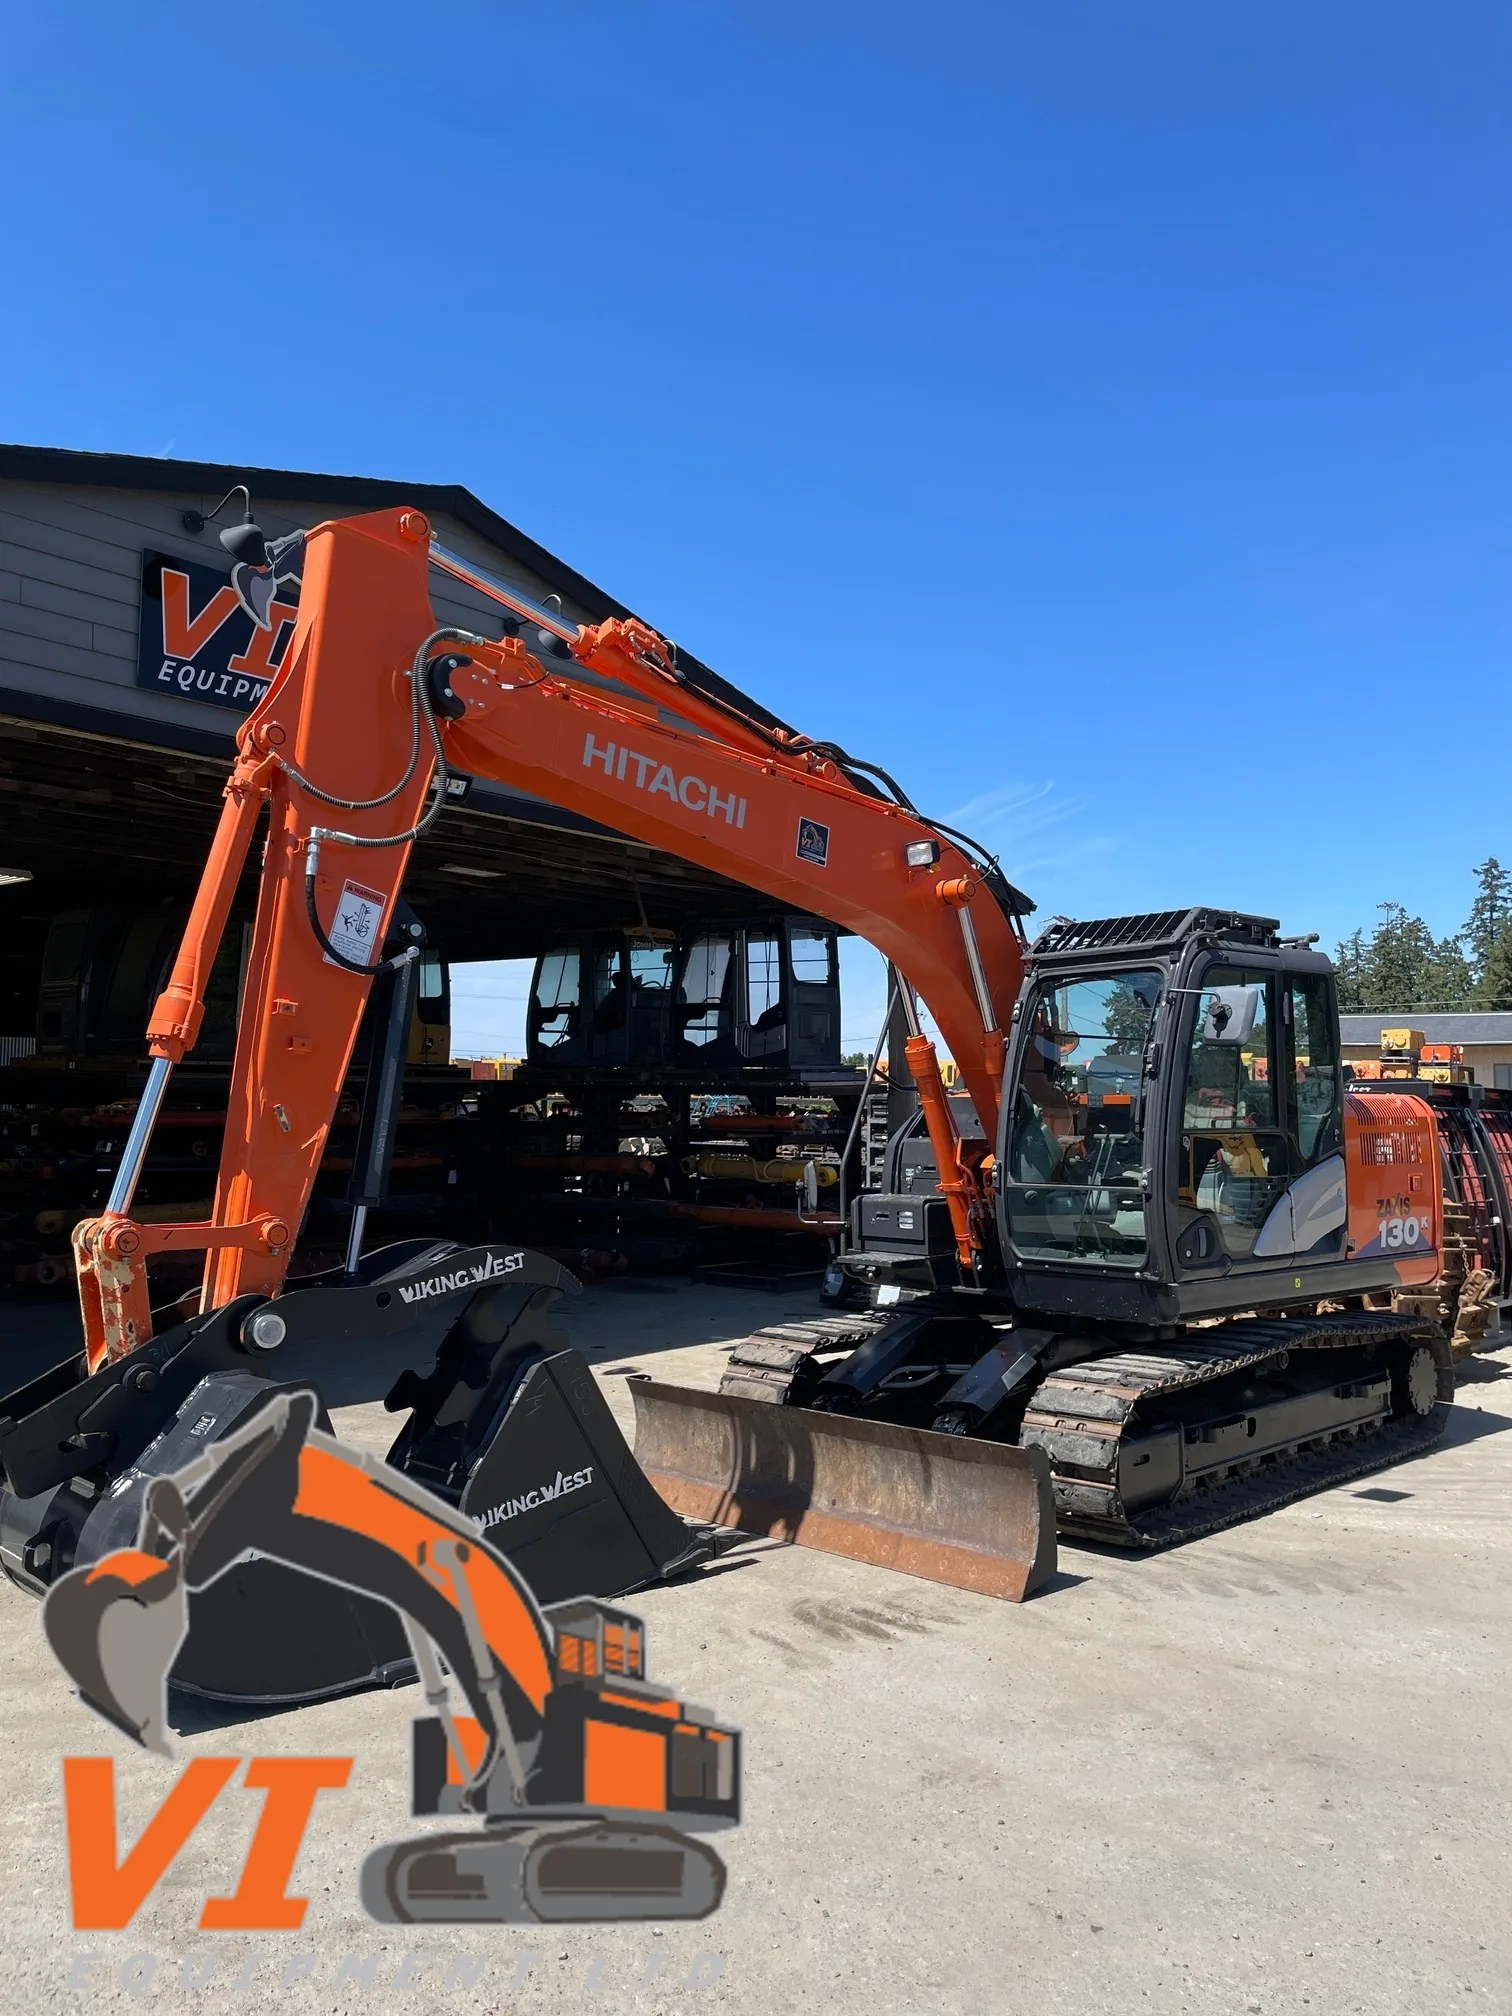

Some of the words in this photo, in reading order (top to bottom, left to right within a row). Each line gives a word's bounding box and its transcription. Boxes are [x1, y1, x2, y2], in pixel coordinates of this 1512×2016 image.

[161, 567, 299, 682] VI
[583, 733, 746, 829] HITACHI
[354, 886, 382, 903] WARNING
[1376, 1192, 1411, 1217] ZAXIS
[399, 1270, 468, 1303] VIKING
[470, 1252, 525, 1282] WEST
[472, 1491, 540, 1532] VIKING
[540, 1466, 594, 1501] WEST
